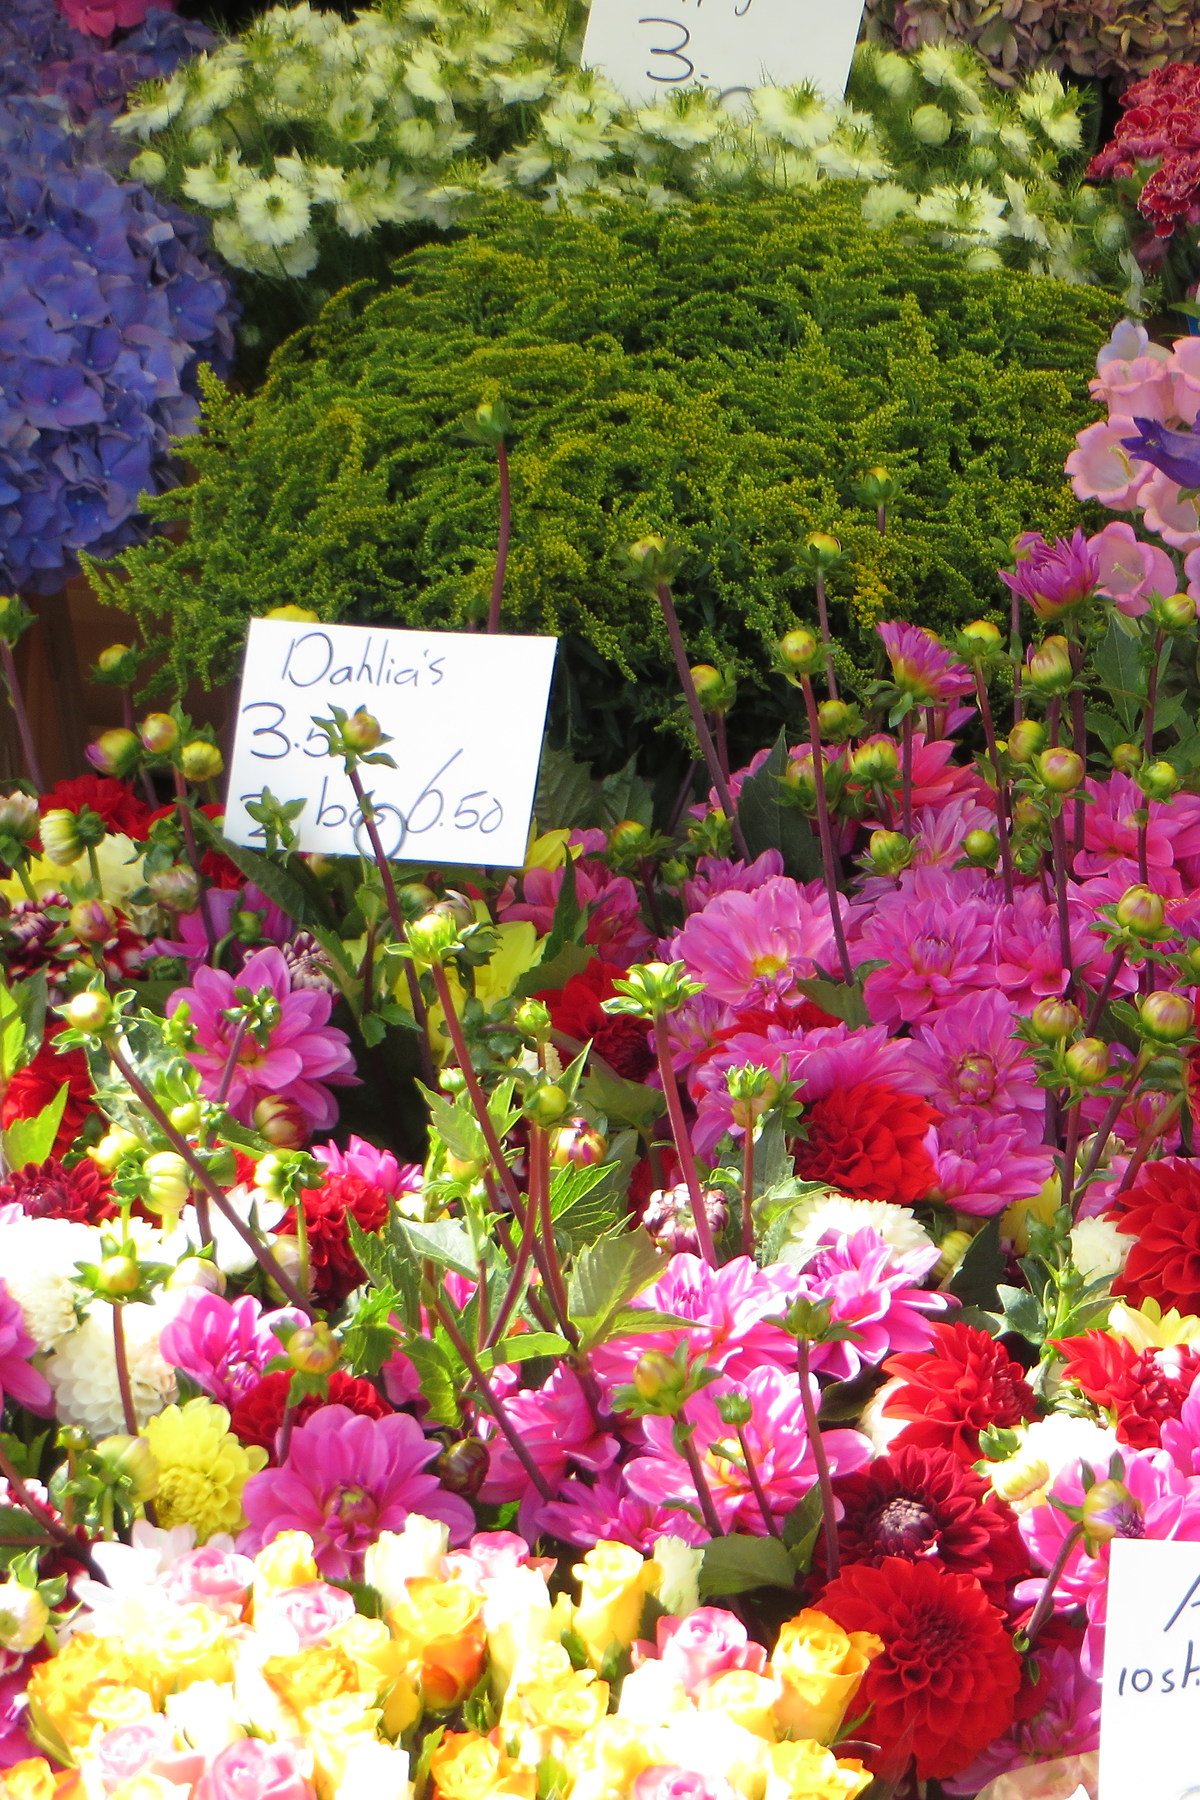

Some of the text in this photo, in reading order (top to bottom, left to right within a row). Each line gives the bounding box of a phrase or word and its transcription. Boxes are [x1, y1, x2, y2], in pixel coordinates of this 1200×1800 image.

[282, 632, 446, 687] Dahlia's
[242, 701, 346, 760] 3.5
[405, 747, 504, 834] 6.50
